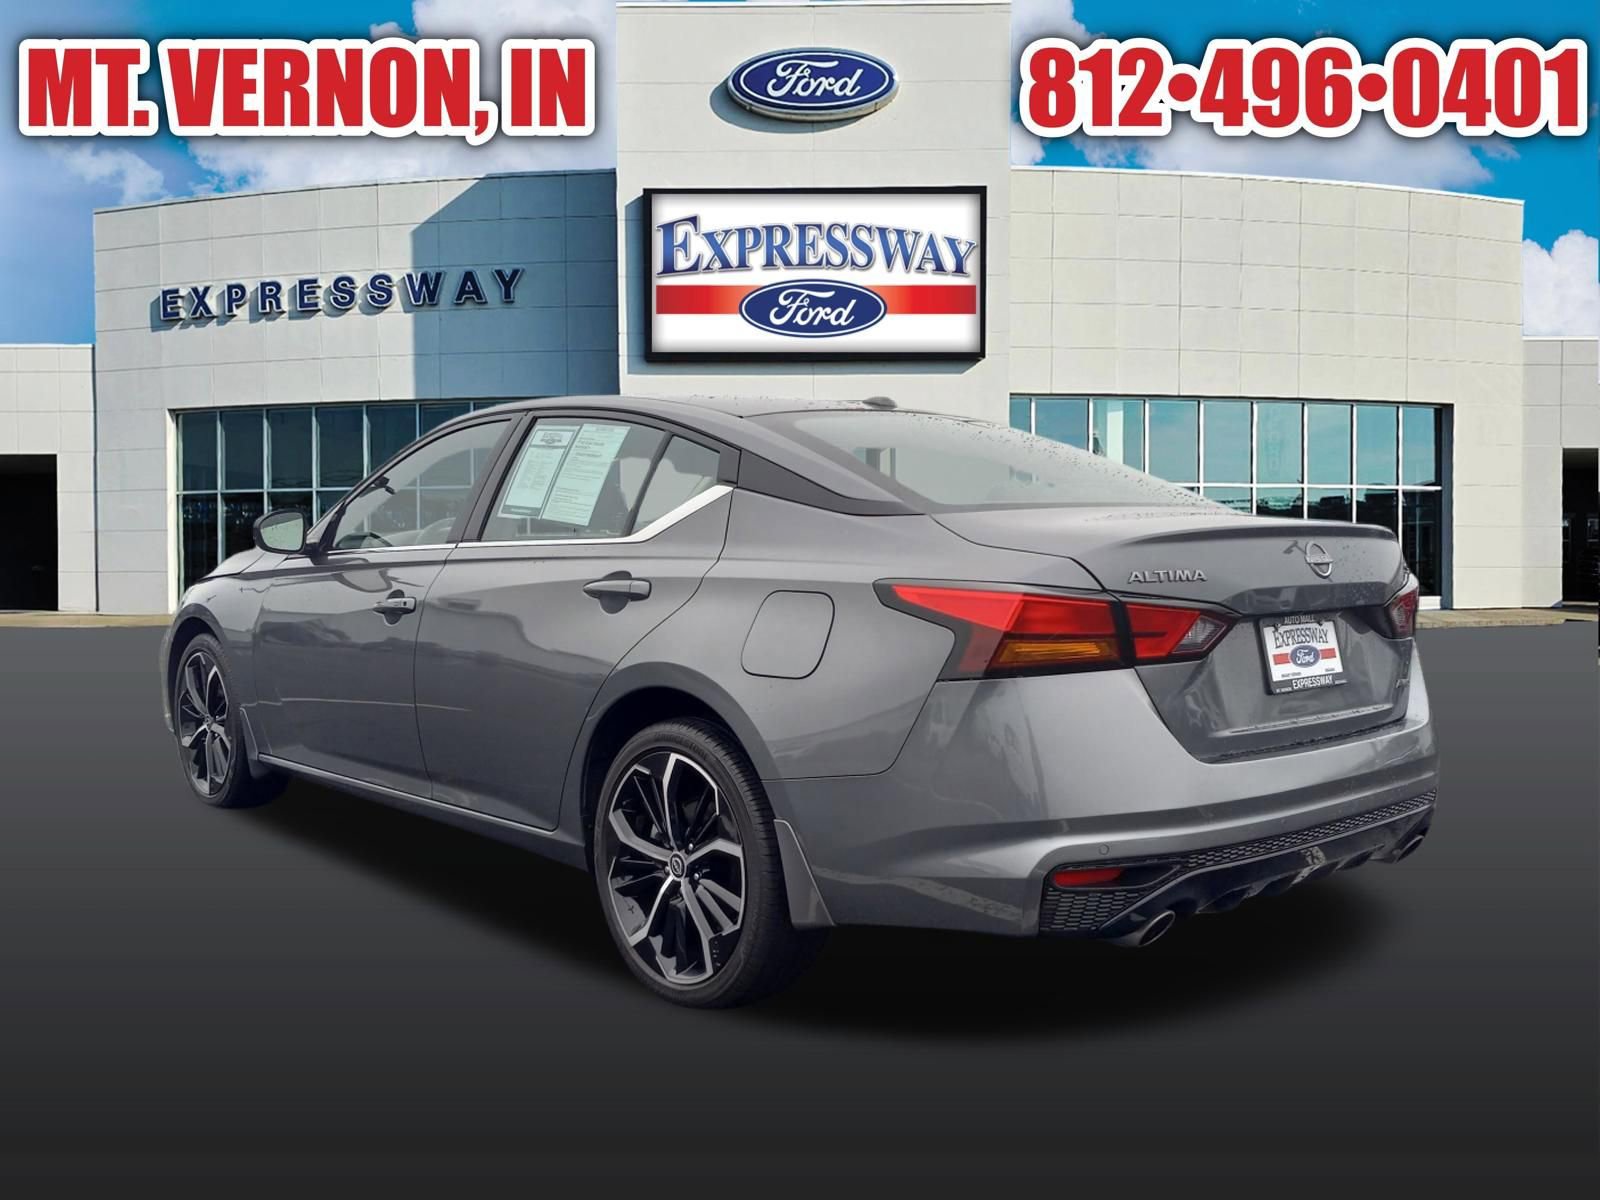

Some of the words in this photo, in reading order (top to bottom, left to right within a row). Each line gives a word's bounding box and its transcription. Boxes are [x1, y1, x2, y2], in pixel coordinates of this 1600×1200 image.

[766, 59, 864, 98] Ford
[655, 213, 977, 278] EXPRESSWAY
[158, 267, 526, 322] EXPRESSWAY
[768, 288, 858, 327] Ford
[1127, 569, 1208, 585] ALTIMA
[1284, 615, 1300, 625] AUTO
[1272, 627, 1329, 649] EXPRESSWAY
[1295, 649, 1316, 664] Ford
[1292, 675, 1334, 690] EXPRESSWAY
